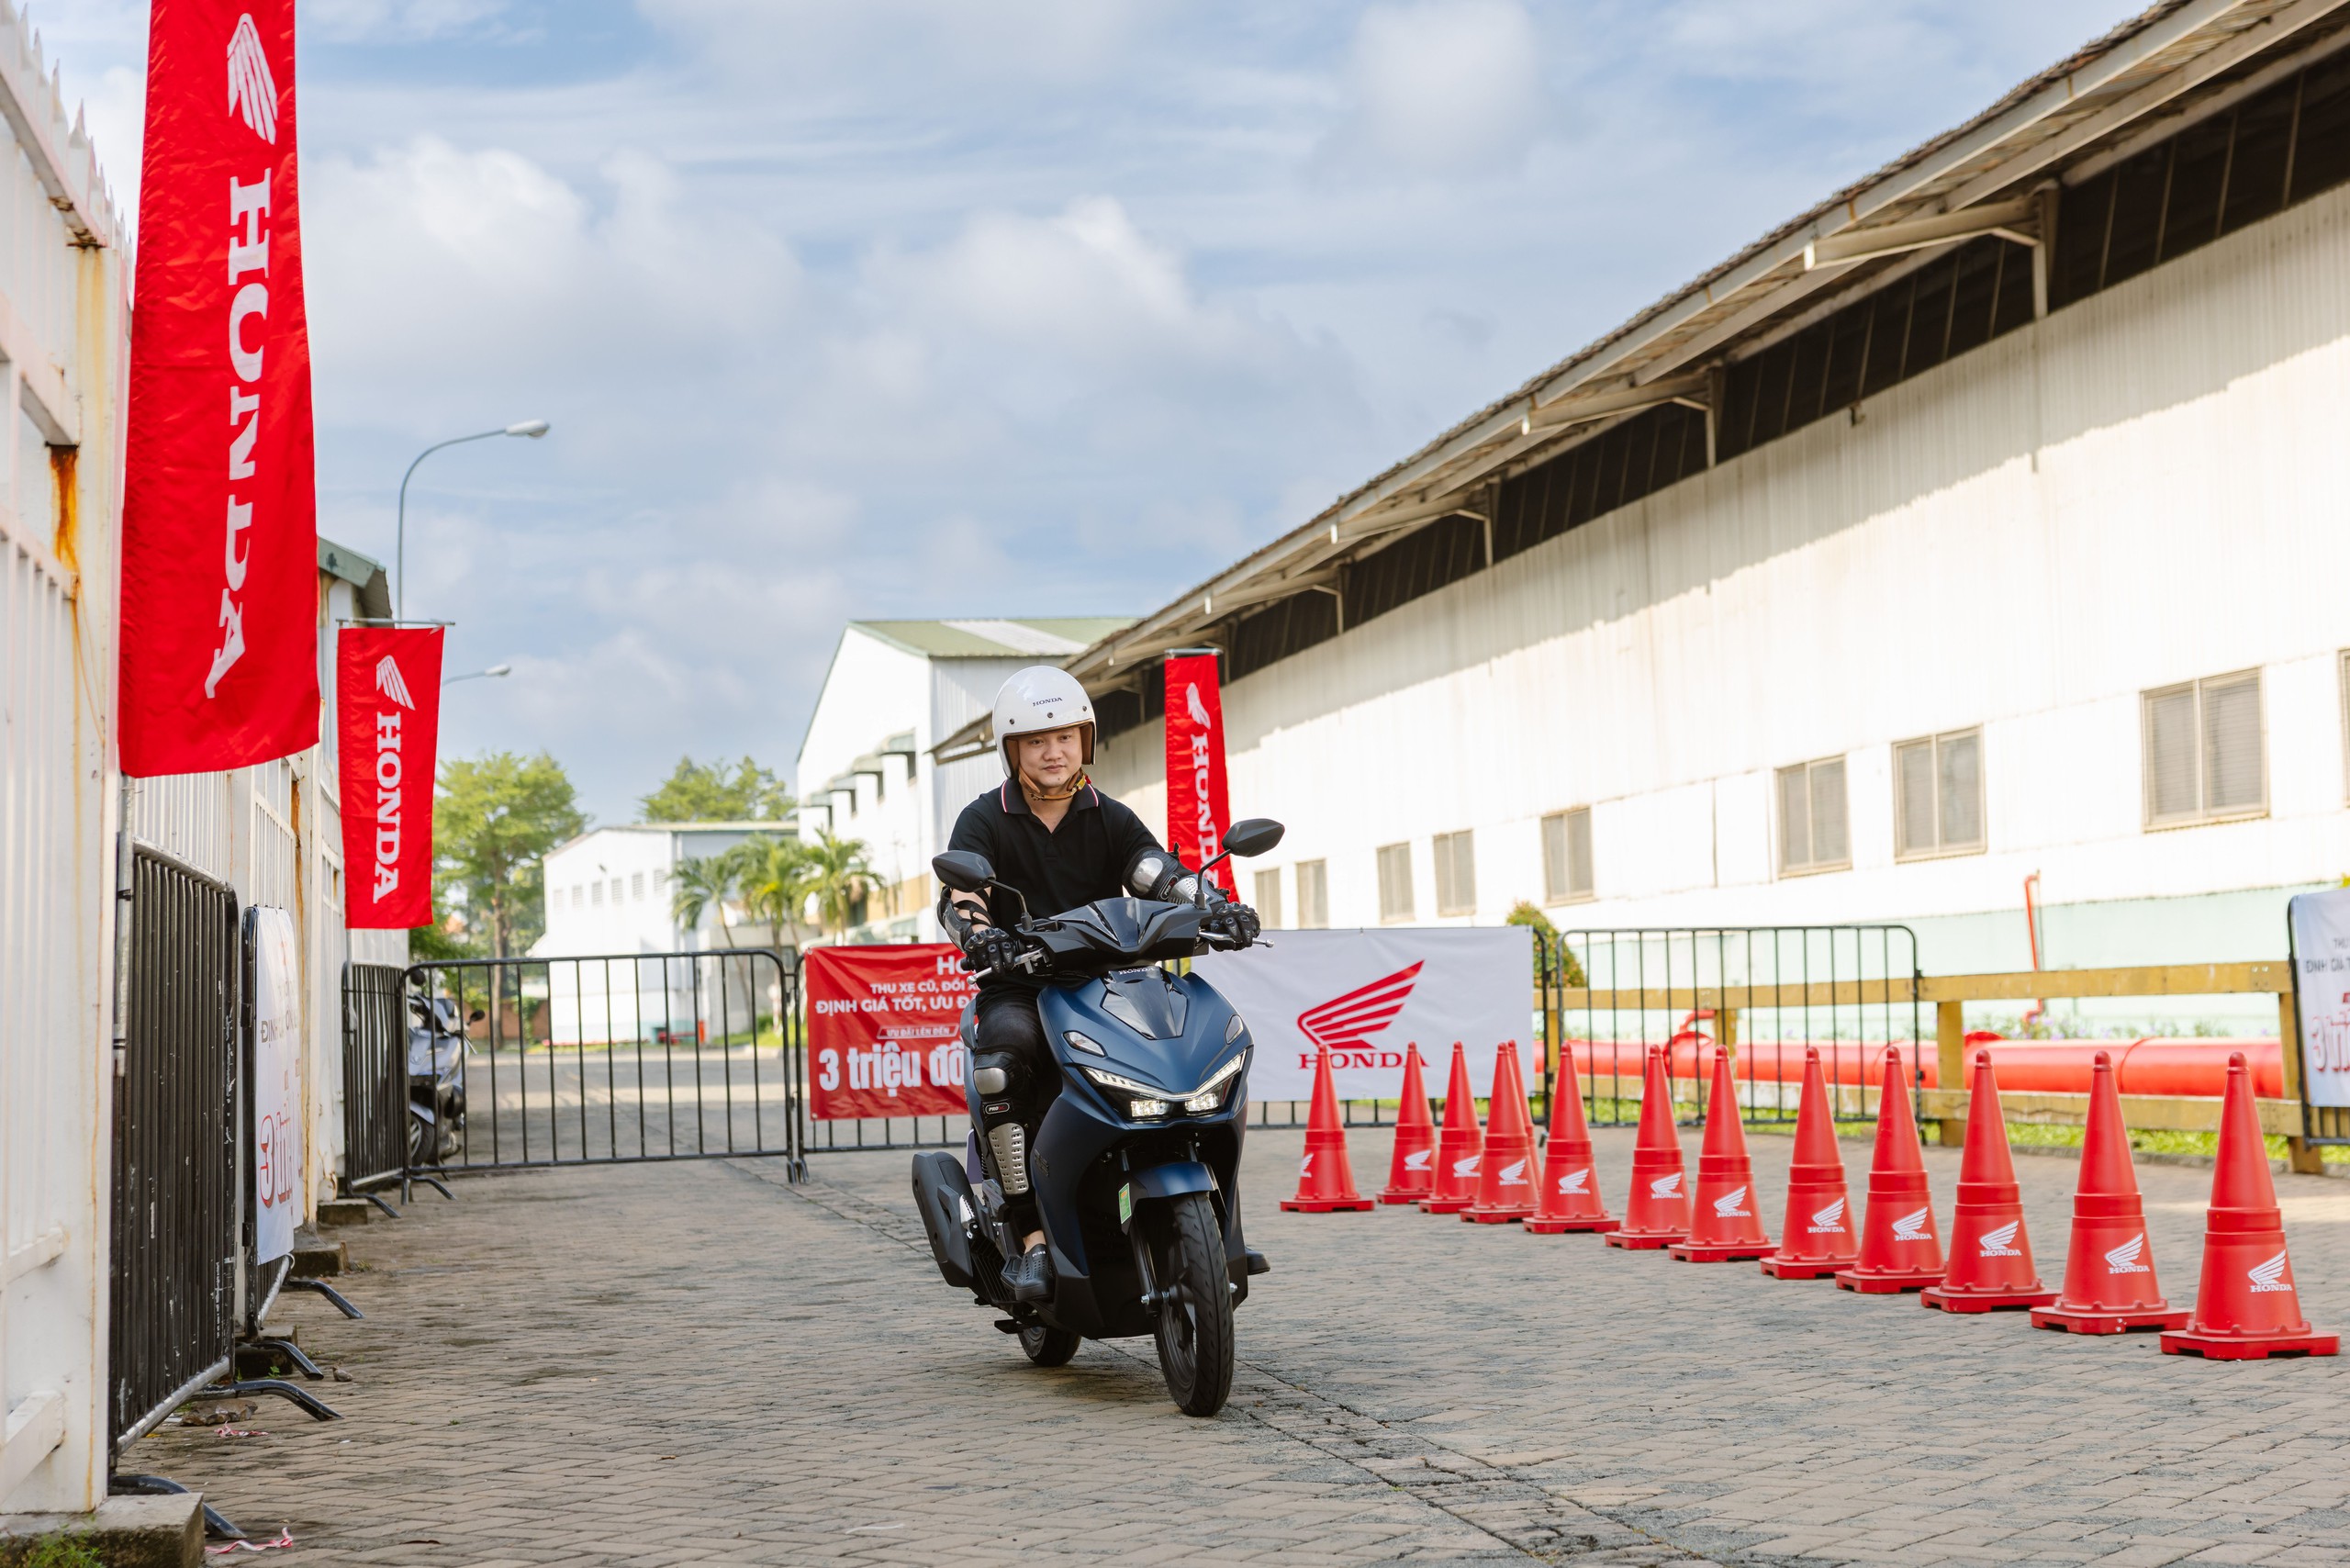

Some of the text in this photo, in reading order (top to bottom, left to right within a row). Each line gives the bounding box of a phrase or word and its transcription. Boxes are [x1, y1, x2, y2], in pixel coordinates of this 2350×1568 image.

[1033, 698, 1063, 706] HONDA
[373, 711, 401, 904] HONDA
[870, 982, 896, 994] THU
[900, 982, 915, 993] XE
[815, 999, 857, 1016] ĐỊNH
[861, 995, 889, 1012] GIÁ
[891, 994, 926, 1012] TỐT,
[818, 1048, 840, 1091] 3
[846, 1041, 922, 1097] triệu
[259, 1114, 274, 1208] 3
[1894, 1233, 1933, 1241] HONDA
[2109, 1265, 2151, 1274] HONDA
[2250, 1283, 2293, 1293] HONDA
